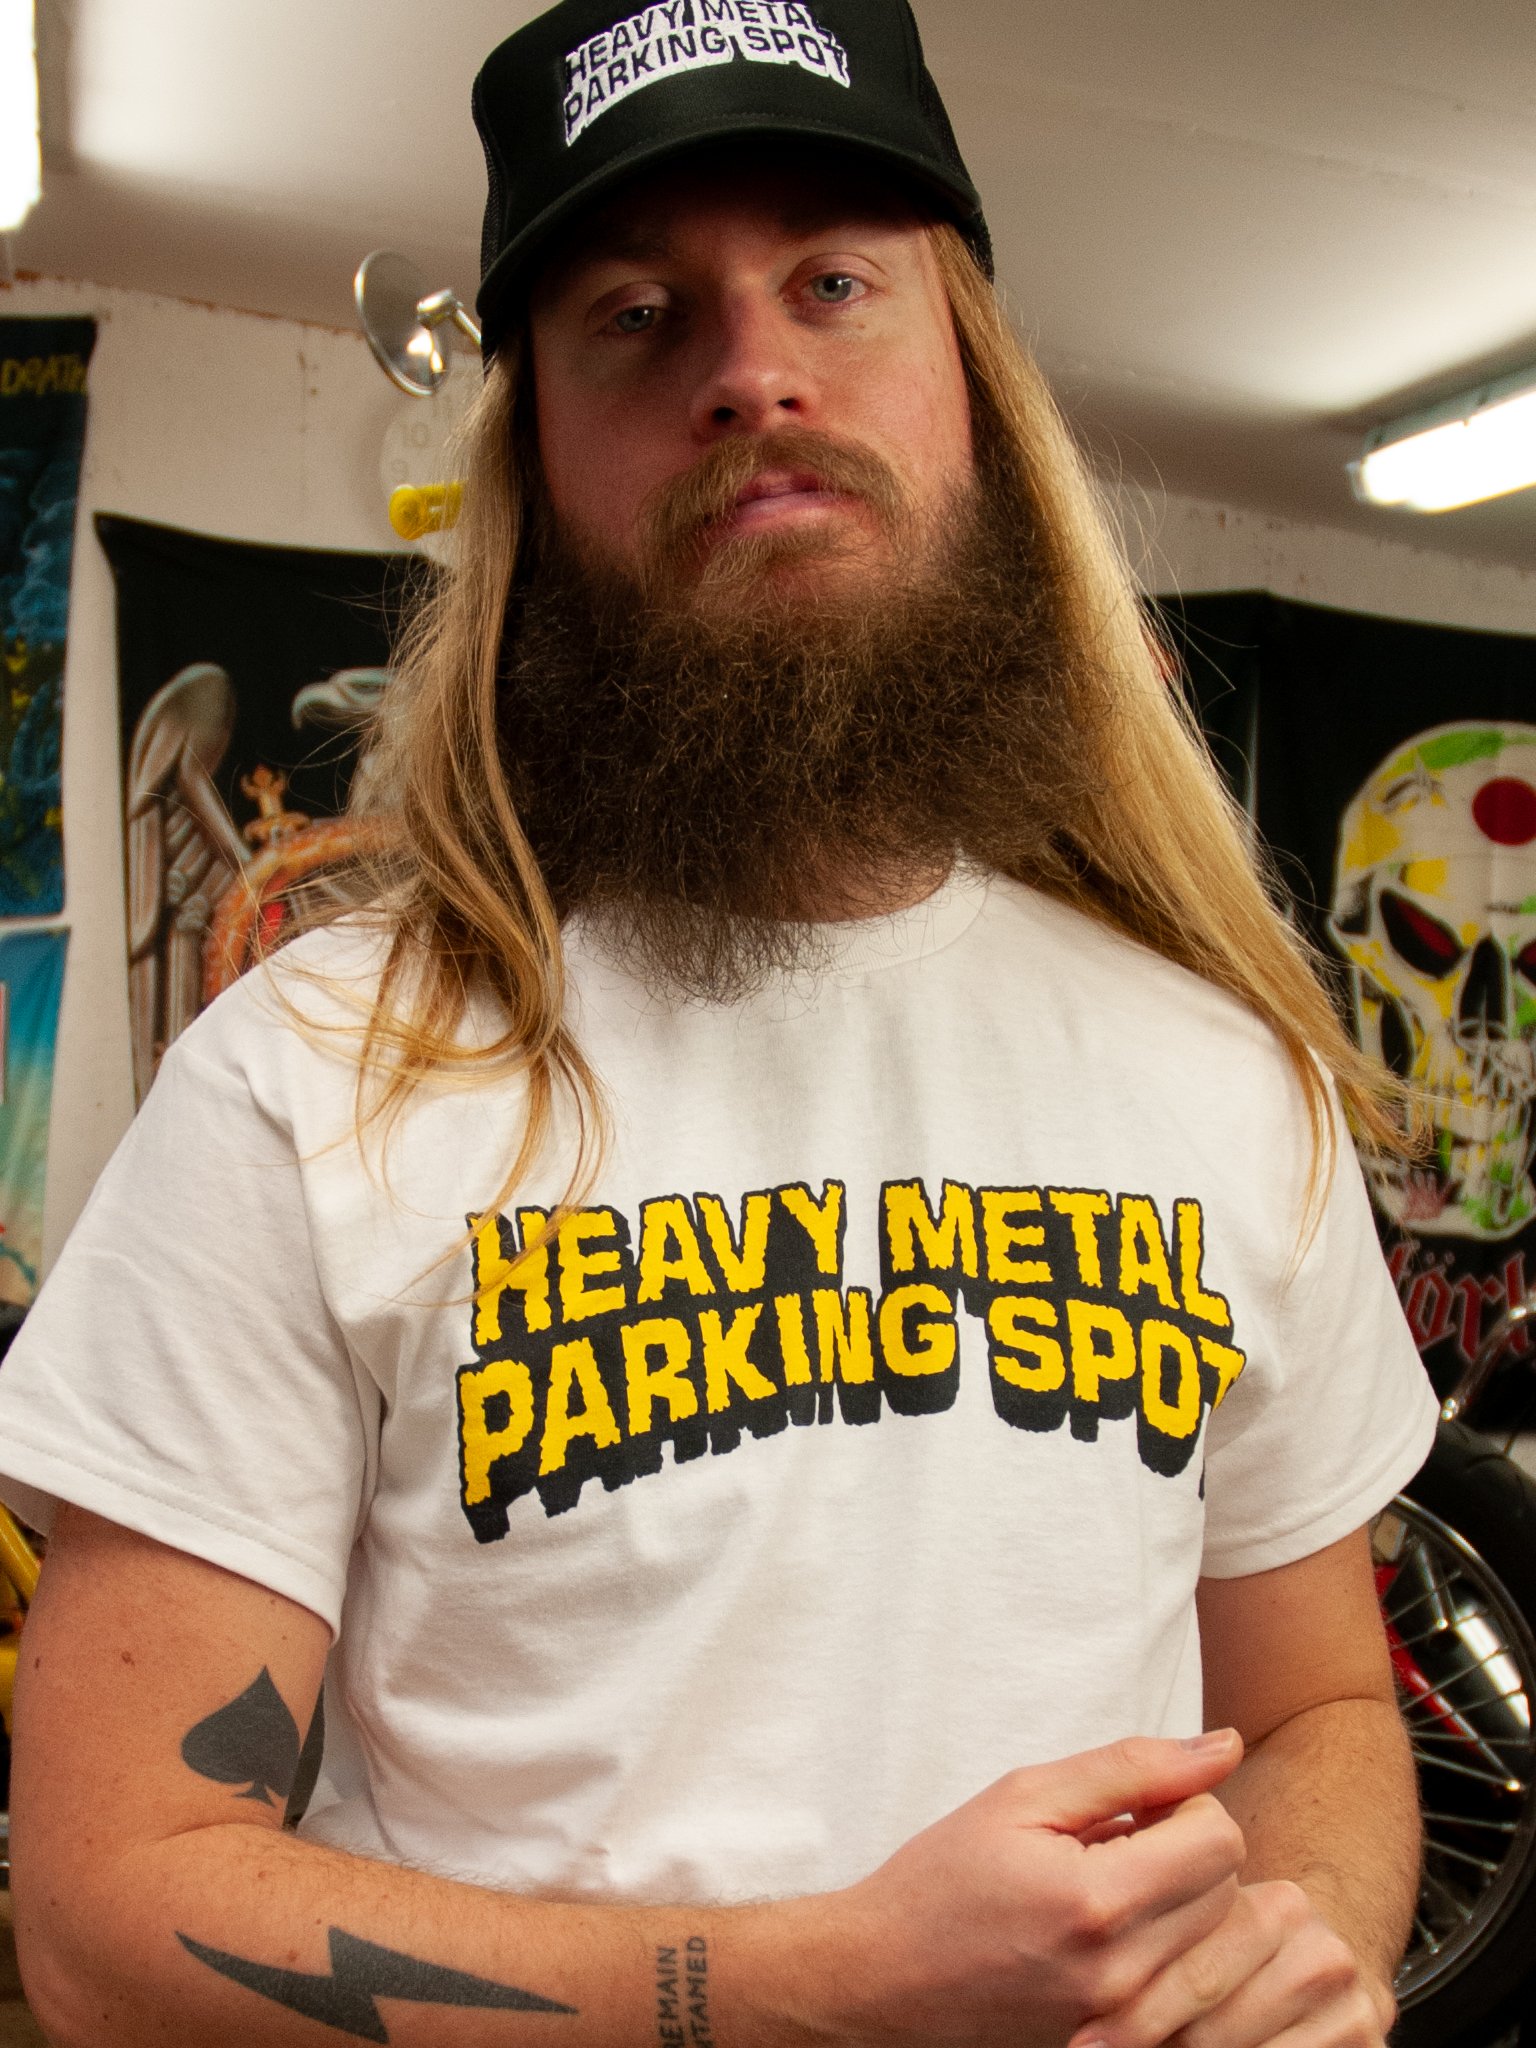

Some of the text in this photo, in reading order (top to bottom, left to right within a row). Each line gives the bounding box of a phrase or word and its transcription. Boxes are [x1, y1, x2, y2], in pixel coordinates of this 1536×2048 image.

[563, 25, 848, 142] PARKING SPOT
[565, 0, 833, 95] HEAVY METAL
[468, 1180, 1232, 1346] HEAVY METAL
[457, 1282, 1246, 1518] PARKING SPOT
